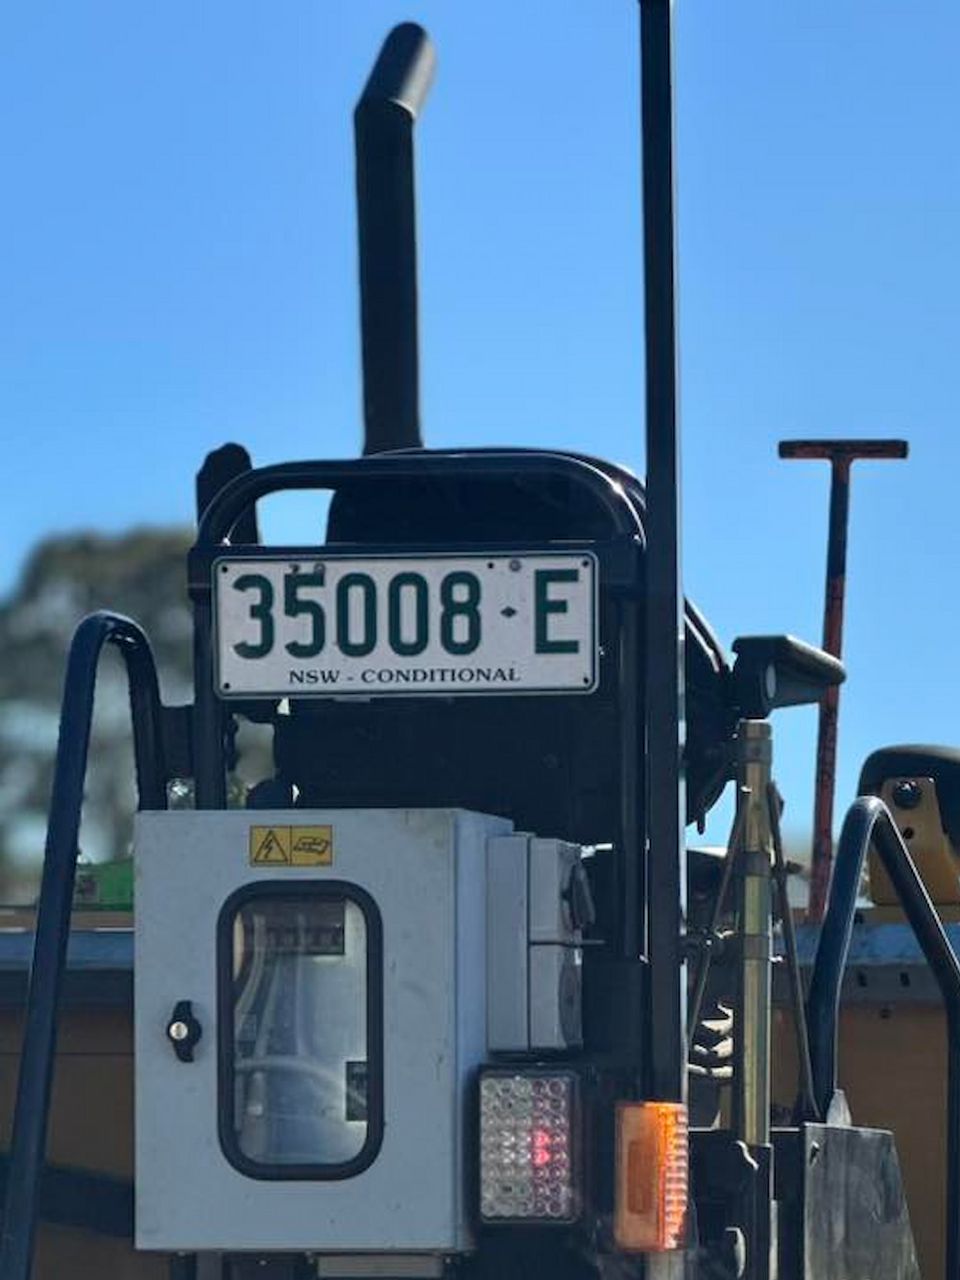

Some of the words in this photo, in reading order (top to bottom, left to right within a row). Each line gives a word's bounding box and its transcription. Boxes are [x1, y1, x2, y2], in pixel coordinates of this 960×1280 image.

[232, 570, 482, 660] 35008
[533, 568, 580, 655] E
[288, 669, 340, 685] NSW
[360, 666, 521, 684] CONDITIONAL
